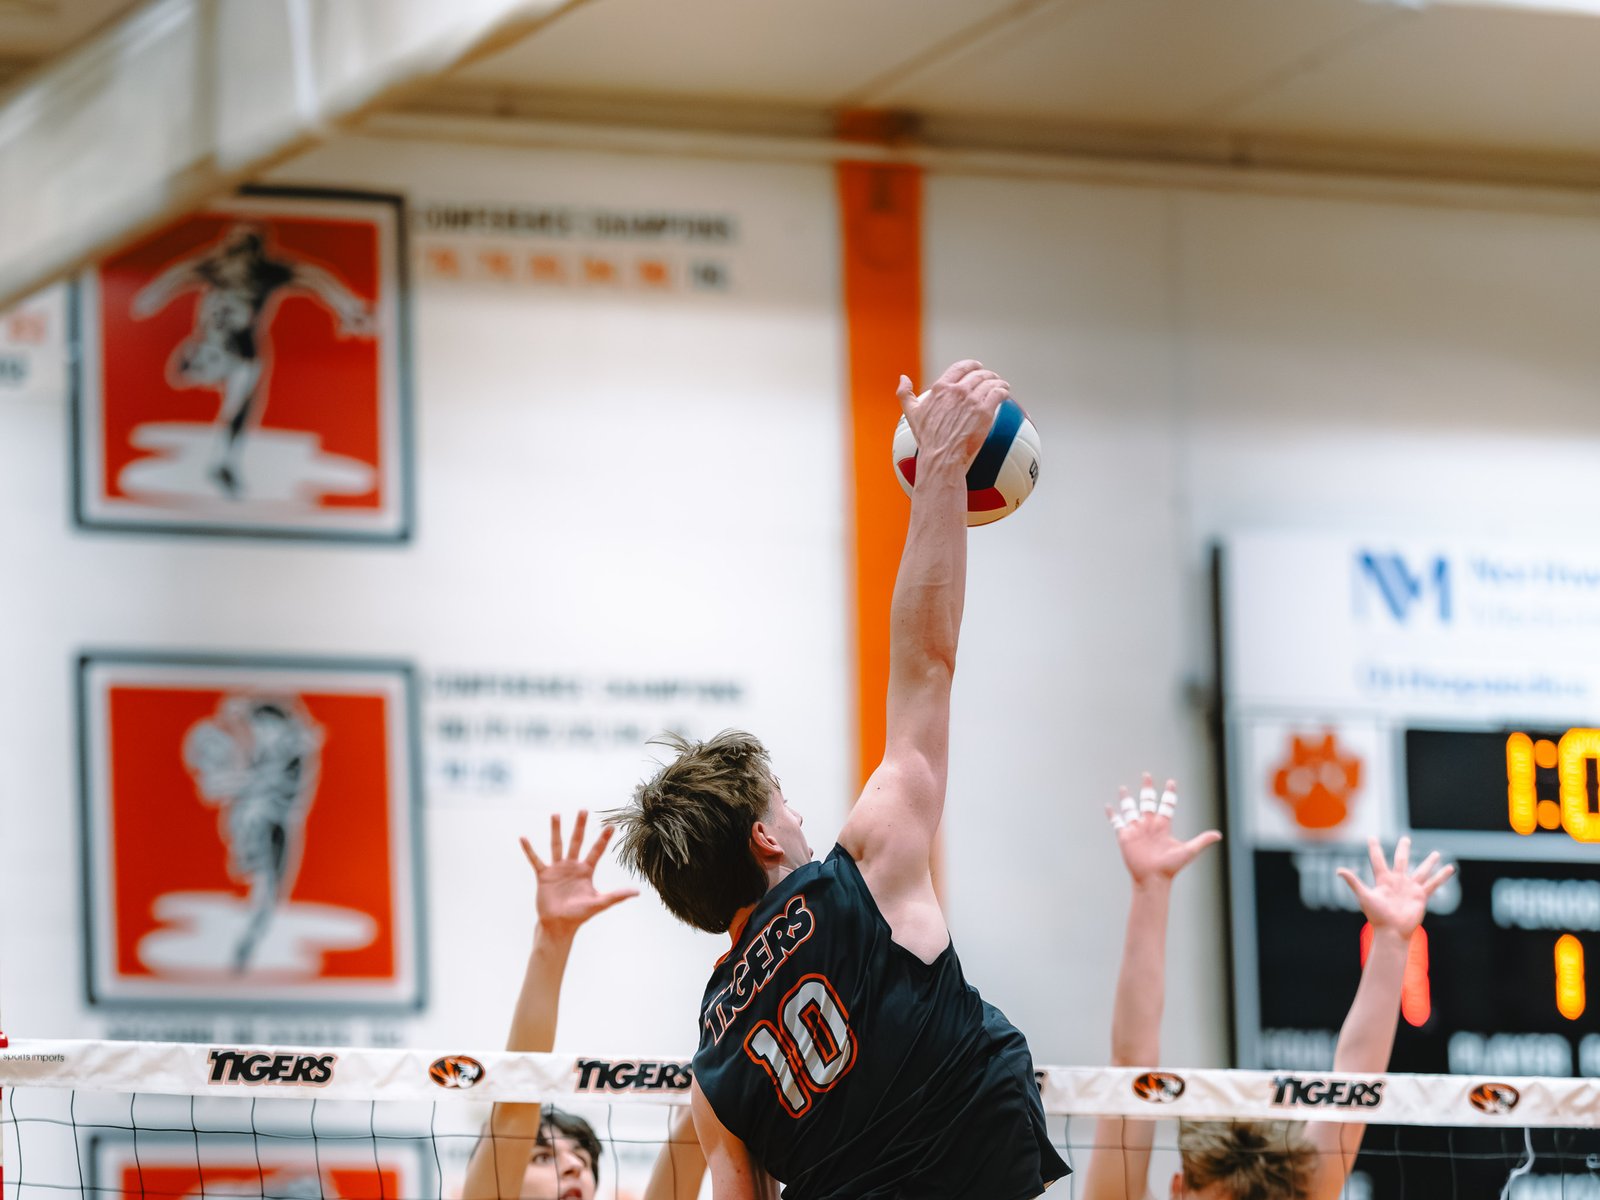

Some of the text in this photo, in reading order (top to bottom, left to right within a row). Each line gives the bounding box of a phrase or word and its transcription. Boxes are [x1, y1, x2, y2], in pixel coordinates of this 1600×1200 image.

[704, 894, 816, 1046] TIGERS
[1555, 934, 1586, 1021] 1
[208, 1049, 338, 1087] TIGERS
[574, 1057, 693, 1093] TIGERS
[744, 973, 857, 1118] 10
[1269, 1076, 1387, 1109] TIGERS
